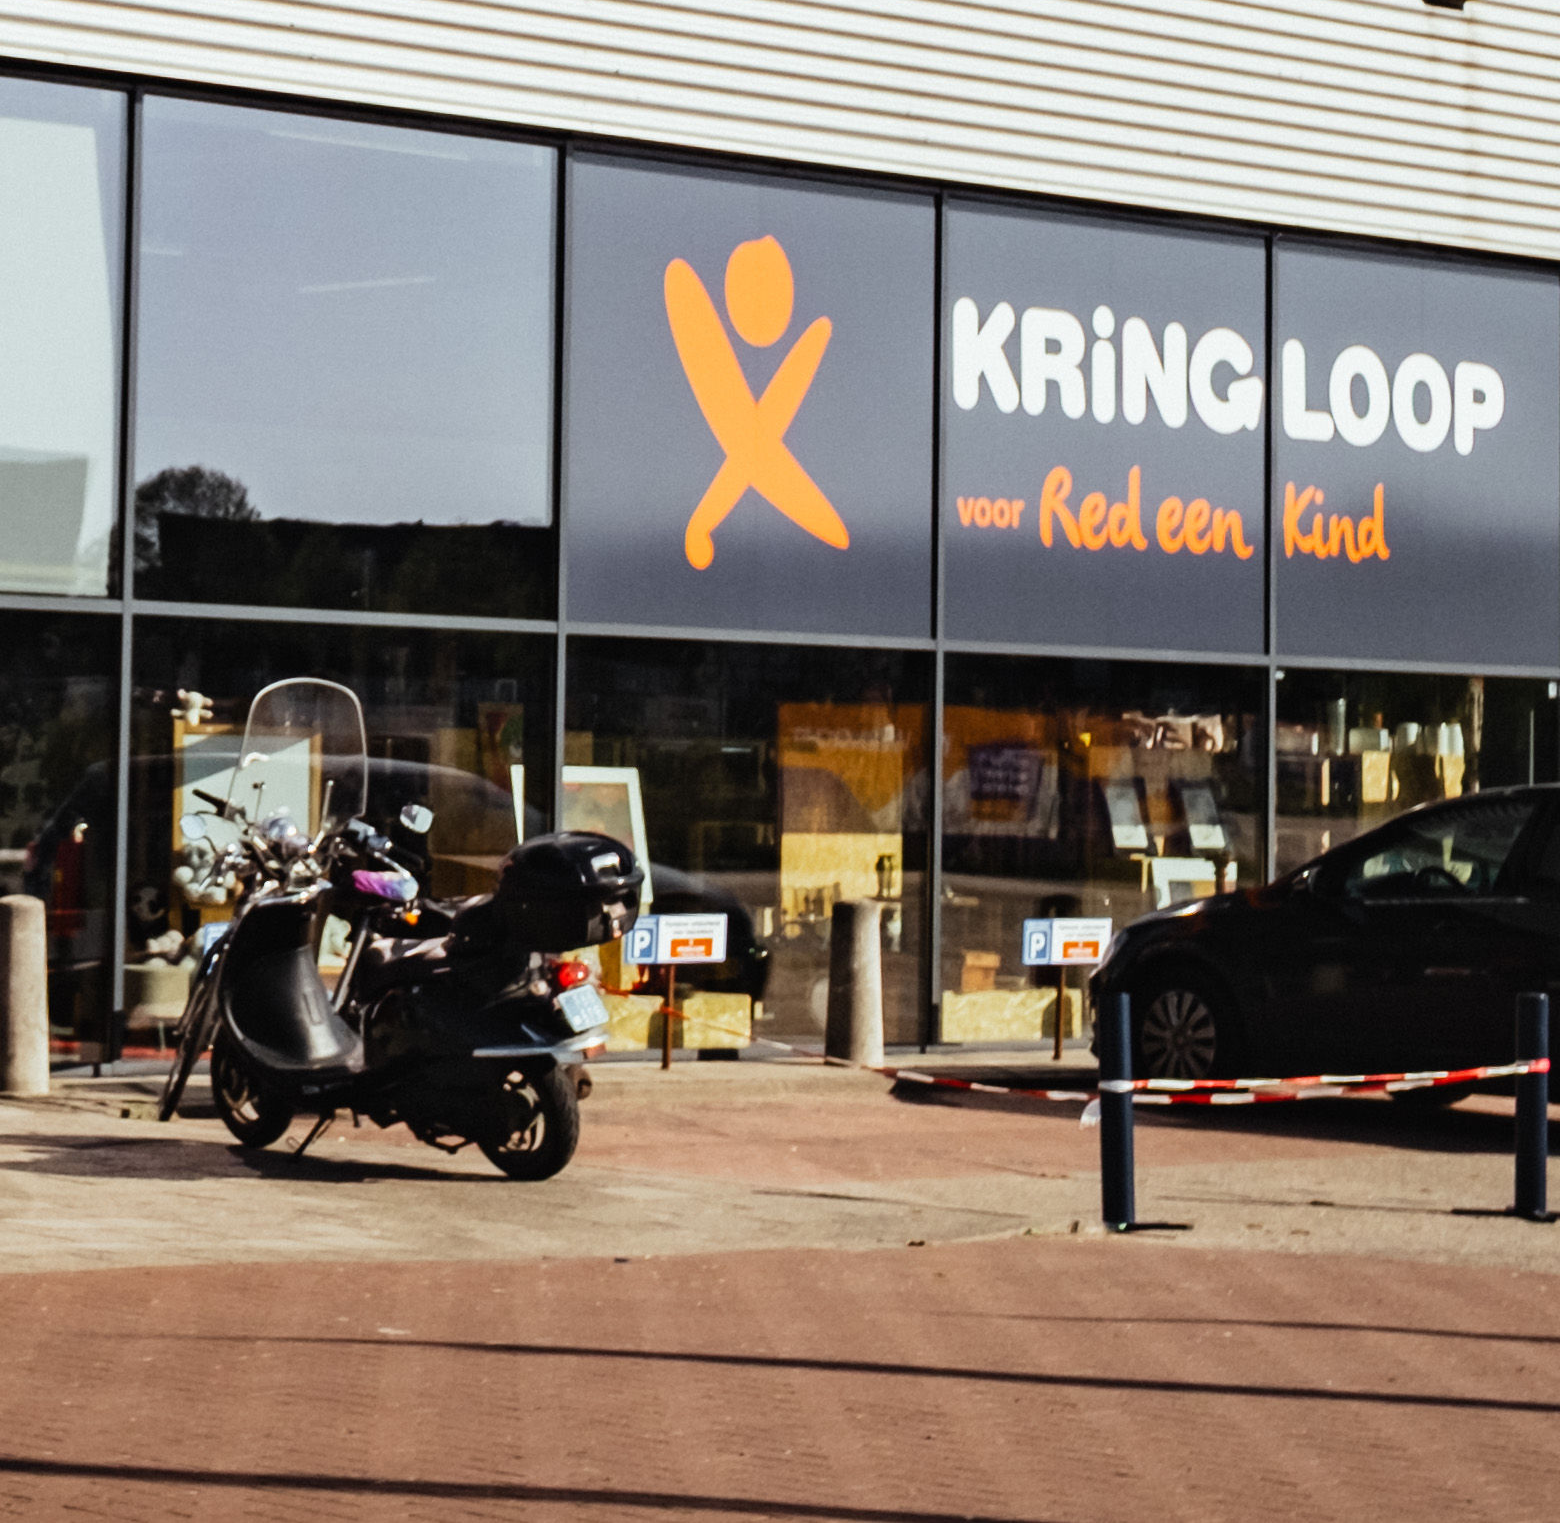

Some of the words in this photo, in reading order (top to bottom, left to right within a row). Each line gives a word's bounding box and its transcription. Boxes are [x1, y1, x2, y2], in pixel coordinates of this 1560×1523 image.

[957, 498, 1025, 528] voor
[1039, 466, 1149, 551] Red
[1156, 496, 1254, 560] een
[1282, 483, 1391, 564] Kind
